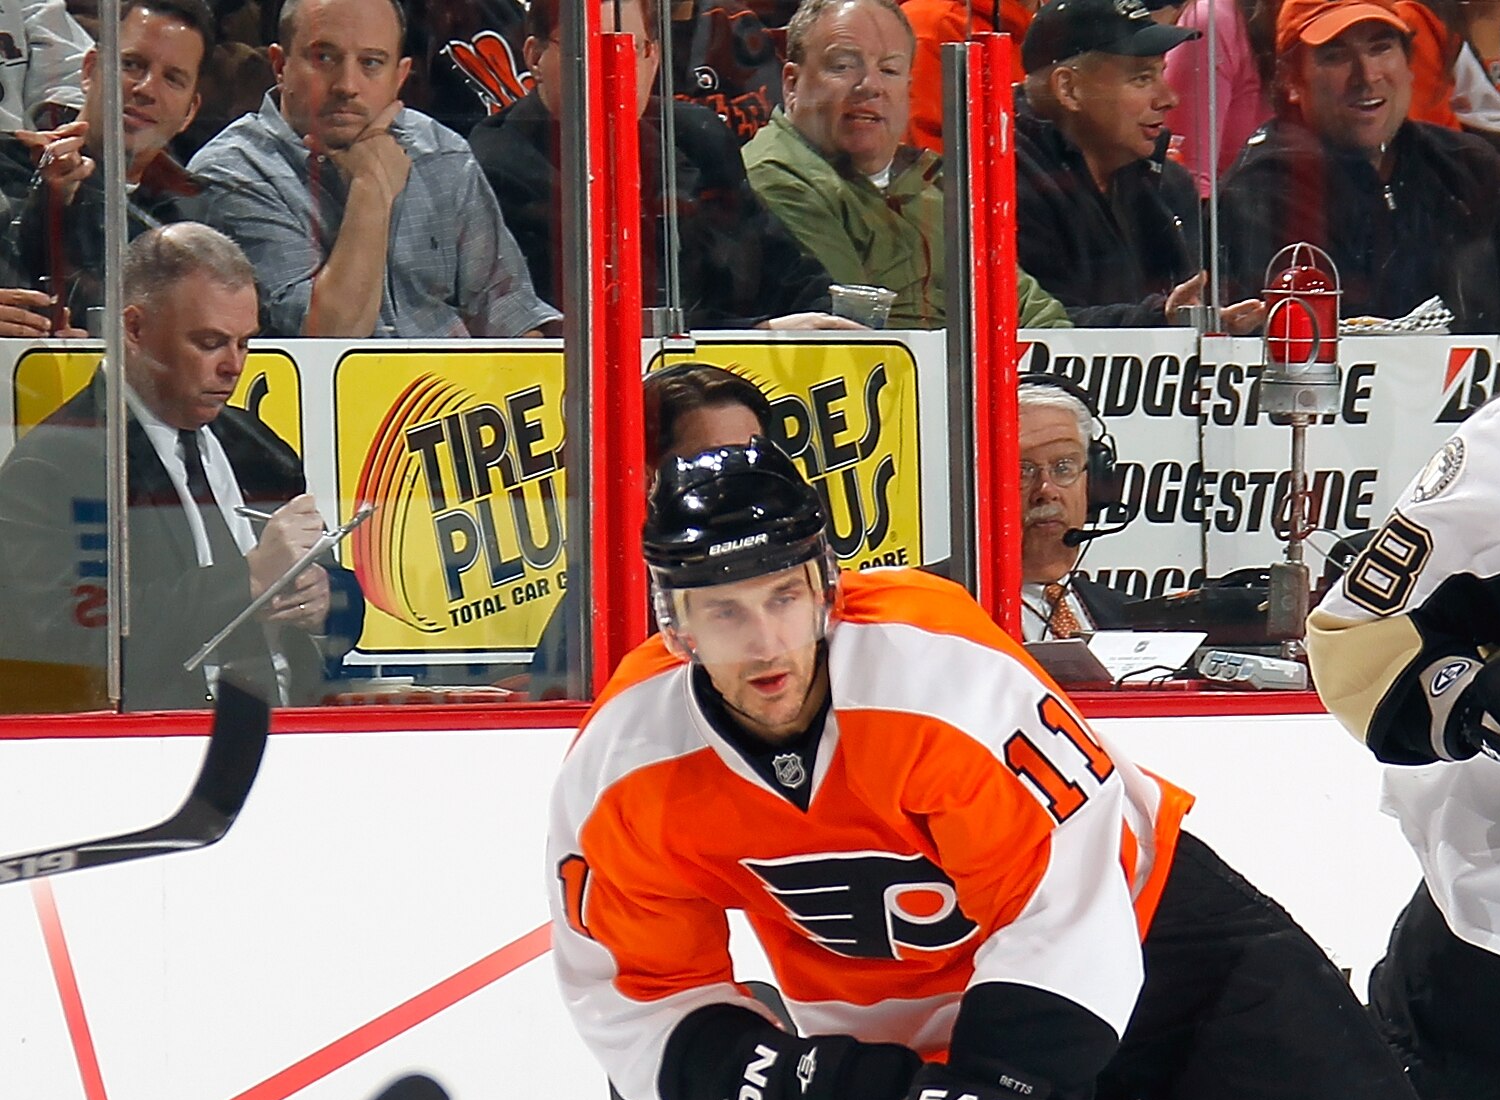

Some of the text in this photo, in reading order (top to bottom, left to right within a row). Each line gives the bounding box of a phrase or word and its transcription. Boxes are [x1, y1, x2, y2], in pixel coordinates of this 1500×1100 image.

[768, 362, 888, 479] RES
[1018, 341, 1376, 426] RIDGESTE
[405, 384, 566, 514] TIRE
[433, 474, 567, 603] PLU
[708, 532, 769, 556] BAUER
[809, 454, 896, 560] US
[1088, 460, 1378, 534] DGESTONE
[448, 595, 506, 627] TOTAL
[511, 578, 551, 606] CAR
[1003, 692, 1115, 825] 11
[999, 1074, 1034, 1095] BETTS
